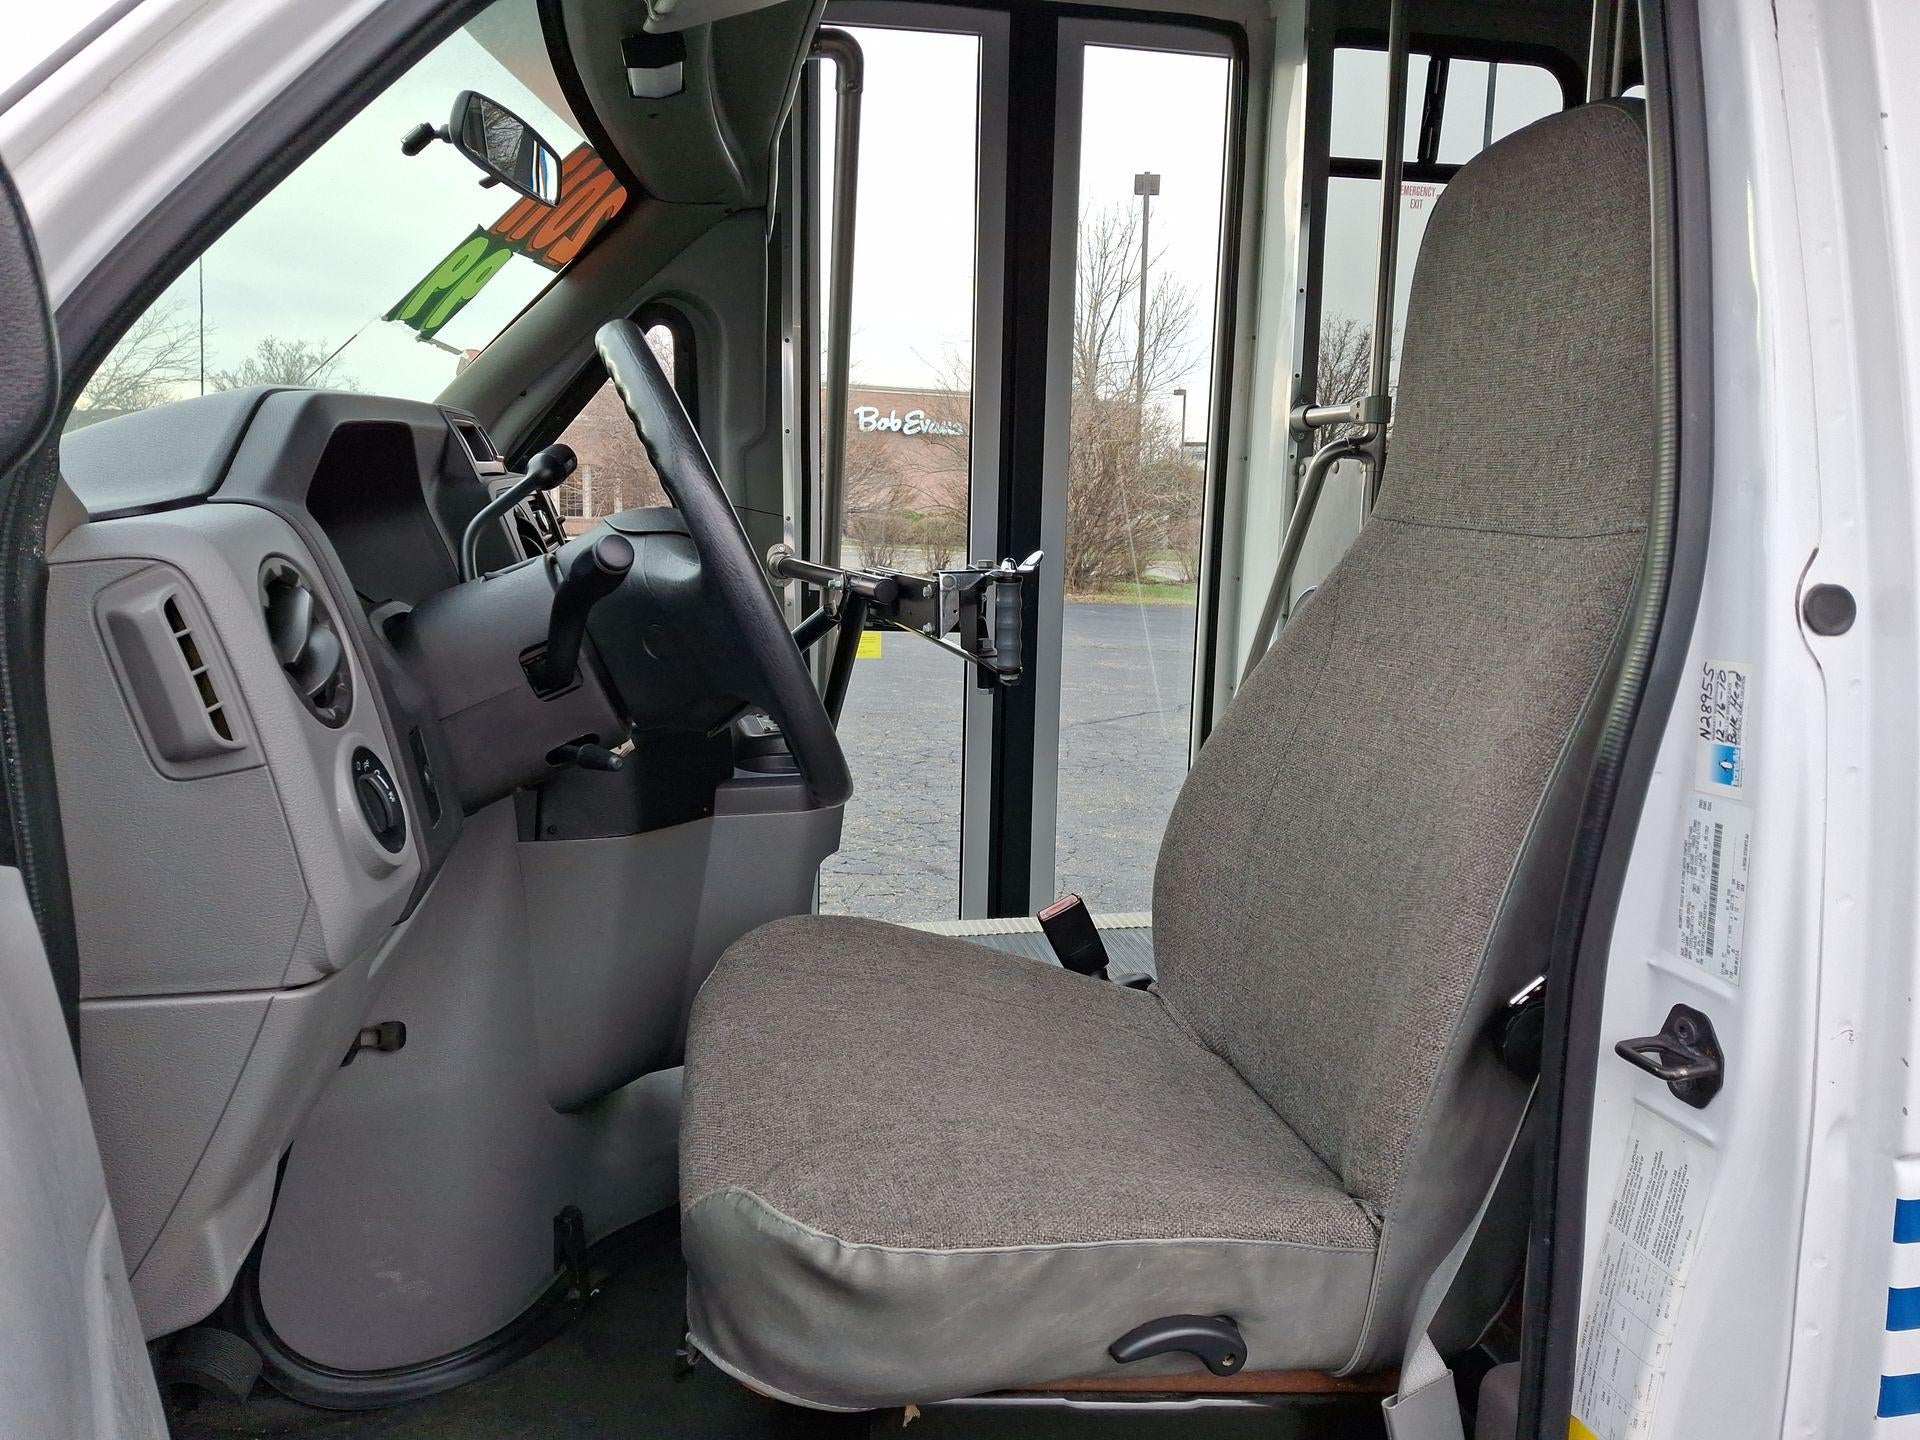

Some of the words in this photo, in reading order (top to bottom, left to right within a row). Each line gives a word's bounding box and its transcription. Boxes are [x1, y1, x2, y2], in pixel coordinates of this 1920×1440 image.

[1401, 185, 1436, 197] EMERGENCY
[1410, 199, 1423, 209] EXIT
[853, 406, 902, 432] Bob
